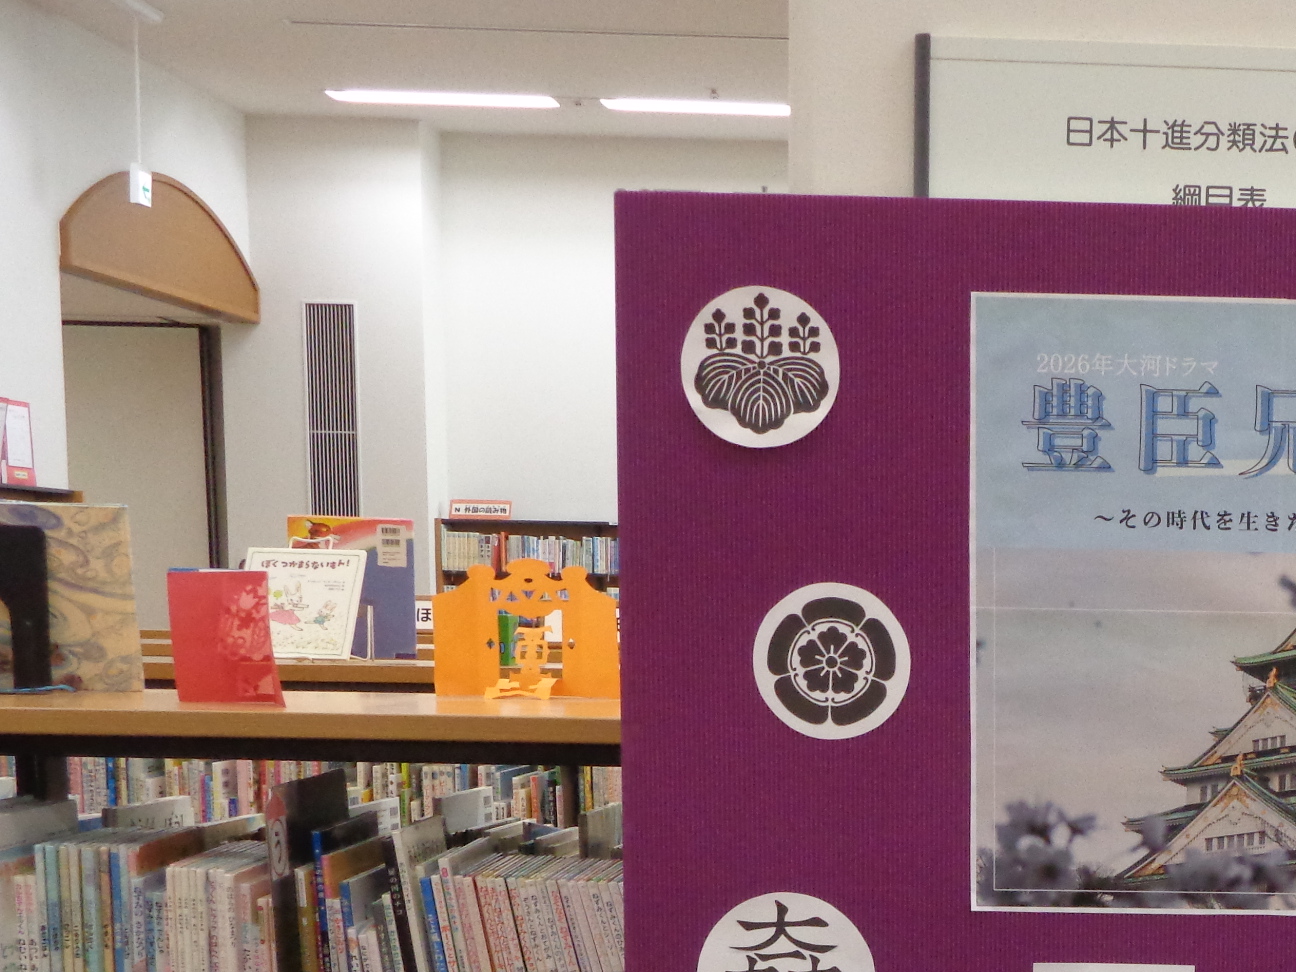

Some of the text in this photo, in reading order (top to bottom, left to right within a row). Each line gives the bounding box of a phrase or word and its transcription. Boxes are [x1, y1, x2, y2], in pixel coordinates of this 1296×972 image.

[1036, 352, 1221, 379] 2026年大河ドラマ
